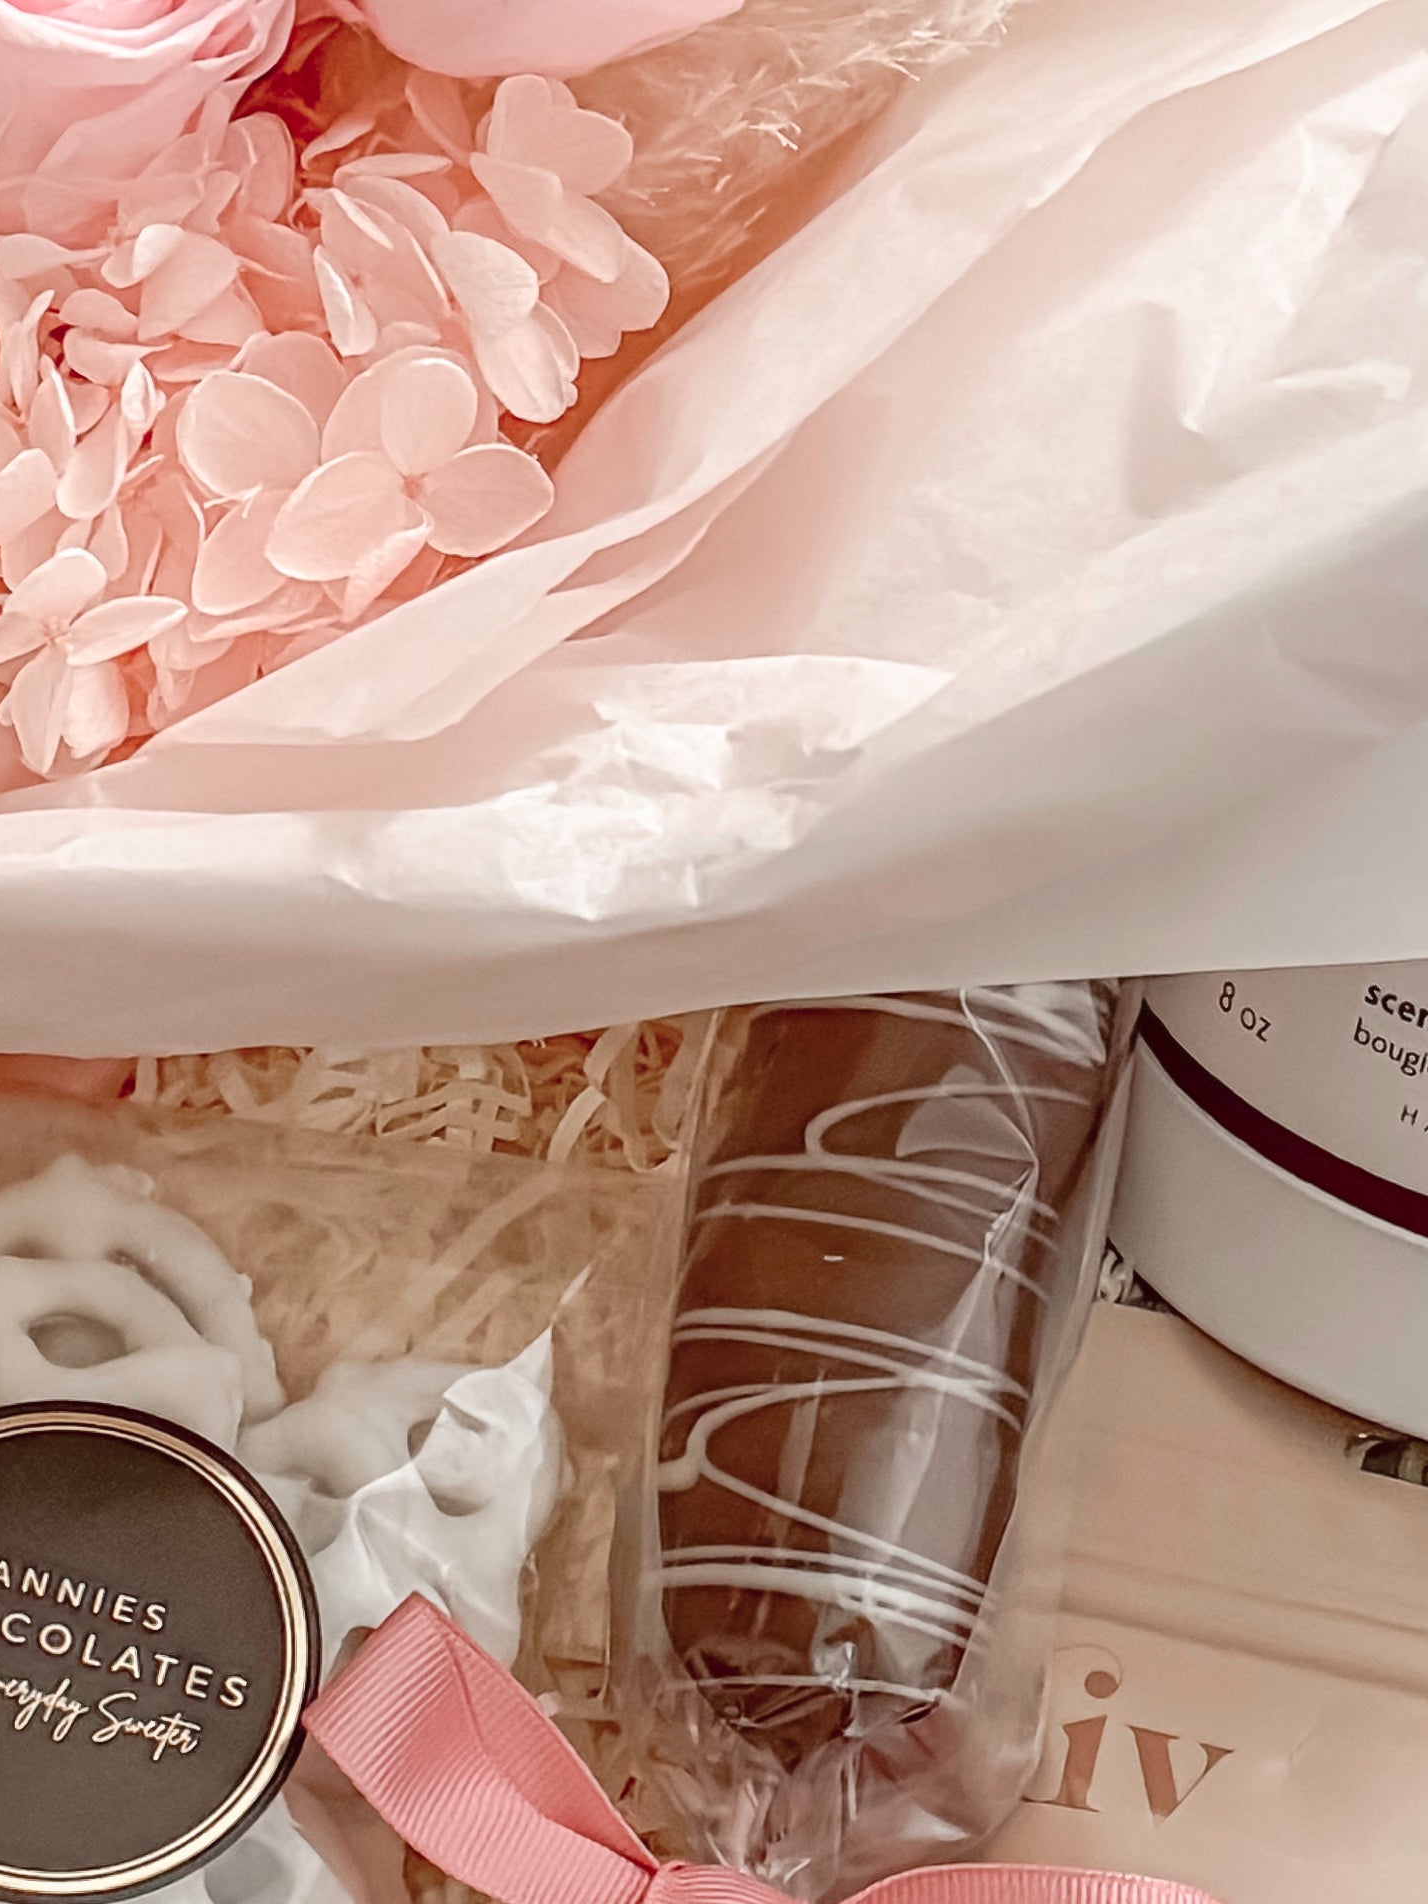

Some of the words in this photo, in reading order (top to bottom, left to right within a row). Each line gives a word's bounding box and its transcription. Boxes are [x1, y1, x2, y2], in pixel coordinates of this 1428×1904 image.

[1218, 980, 1236, 1013] 8
[1239, 1006, 1273, 1043] oz
[91, 1691, 202, 1762] Sweeter
